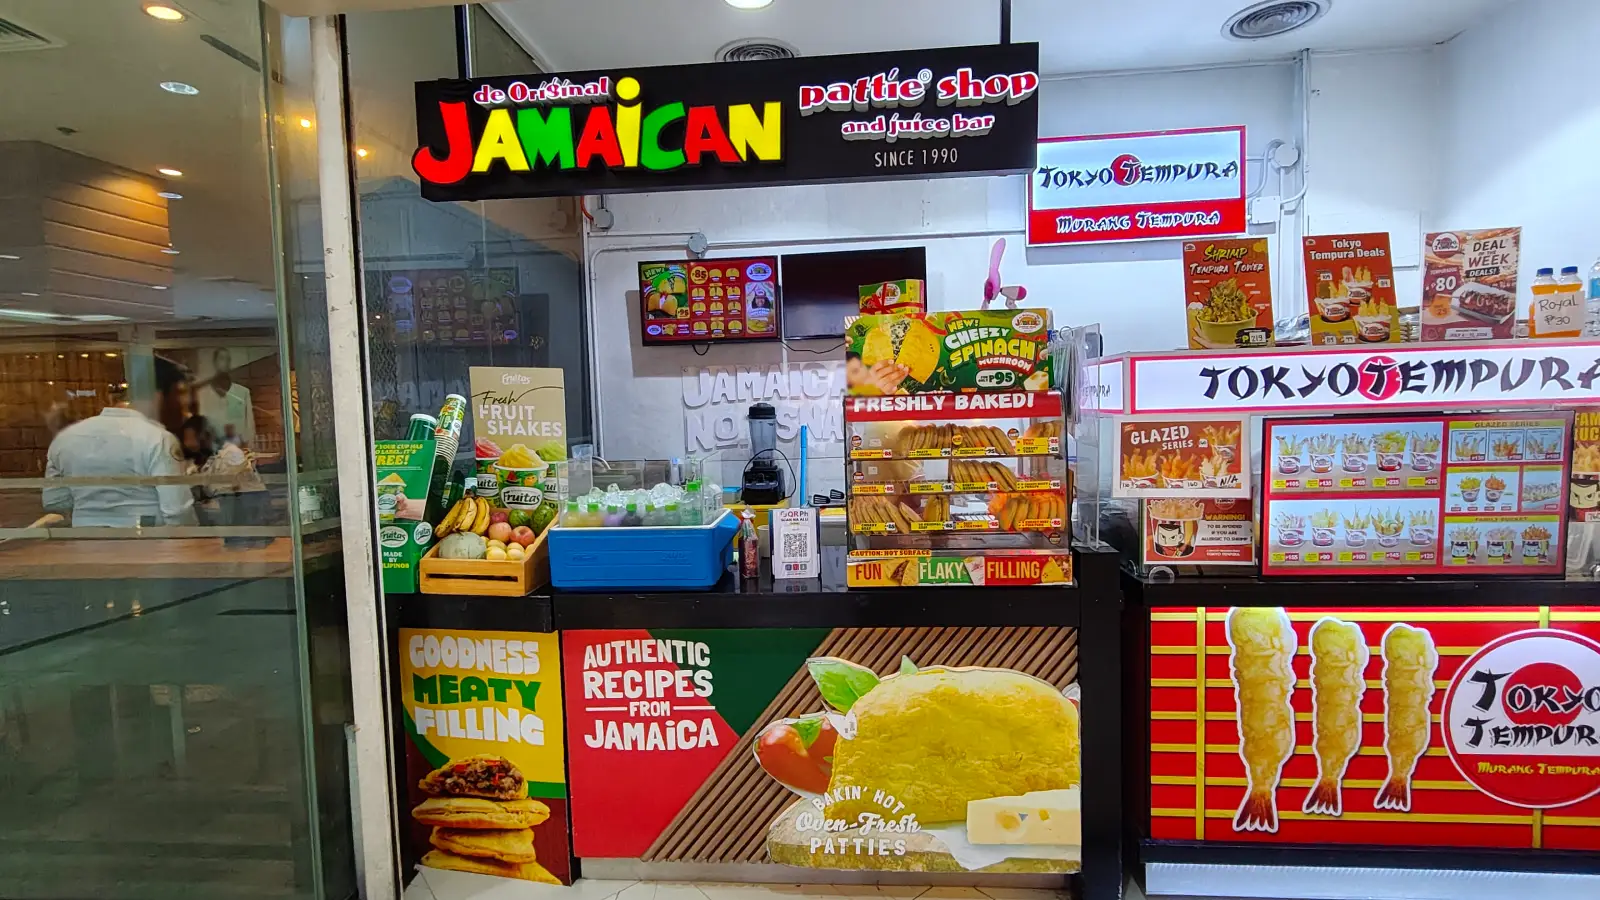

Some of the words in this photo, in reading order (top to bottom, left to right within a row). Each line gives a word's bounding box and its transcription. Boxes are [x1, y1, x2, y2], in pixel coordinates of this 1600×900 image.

[473, 84, 505, 104] de
[507, 77, 609, 102] Original
[937, 67, 1039, 100] shop
[841, 117, 886, 135] and
[888, 112, 950, 137] juice
[952, 113, 995, 132] bar
[874, 151, 914, 168] SINCE
[922, 148, 959, 165] 1990
[1038, 165, 1113, 190] TOKYO
[1121, 160, 1239, 186] TEMPURA
[1056, 213, 1131, 234] MURANG
[1137, 210, 1221, 229] TEMPURA
[1203, 244, 1248, 261] SHRIMP
[1331, 239, 1361, 250] Tokyo
[1473, 240, 1506, 252] DEAL
[1310, 250, 1354, 262] Tempura
[1356, 247, 1385, 258] Deals
[1468, 253, 1510, 268] WEEK
[1189, 263, 1230, 275] TEMPURA
[1234, 260, 1264, 273] TOWER
[1469, 268, 1497, 277] DEALS!
[1538, 294, 1580, 311] Royal
[947, 319, 980, 333] NEW!
[945, 327, 1011, 350] CHEEZY
[949, 337, 1036, 368] SPINACH
[978, 356, 1033, 372] MUSHROOM
[502, 372, 531, 385] Fruitas
[1199, 361, 1358, 401] TOKYO
[853, 395, 946, 412] FRESHLY
[954, 391, 1034, 410] BAKED!
[479, 404, 535, 420] FRUIT
[487, 420, 563, 437] SHAKES
[1130, 425, 1190, 445] GLAZED
[1161, 439, 1194, 451] SERIES
[1220, 475, 1239, 487] N/A
[503, 490, 541, 503] Fruitas
[1205, 513, 1246, 521] WARNING!
[855, 563, 882, 581] FUN
[920, 562, 964, 580] FLAKY
[987, 561, 1040, 580] FILLING
[409, 635, 541, 675] GOODNESS
[583, 639, 711, 670] AUTHENTIC
[412, 672, 542, 712] MEATY
[583, 669, 714, 700] RECIPES
[1467, 668, 1600, 714] TOKYO
[629, 701, 671, 717] FROM
[414, 706, 545, 746] FILLING
[1461, 716, 1600, 748] TEMPUR
[1477, 761, 1534, 775] MURANG
[812, 785, 868, 812] BAKIN'
[872, 789, 905, 815] HOT
[809, 837, 907, 856] PATTIES
